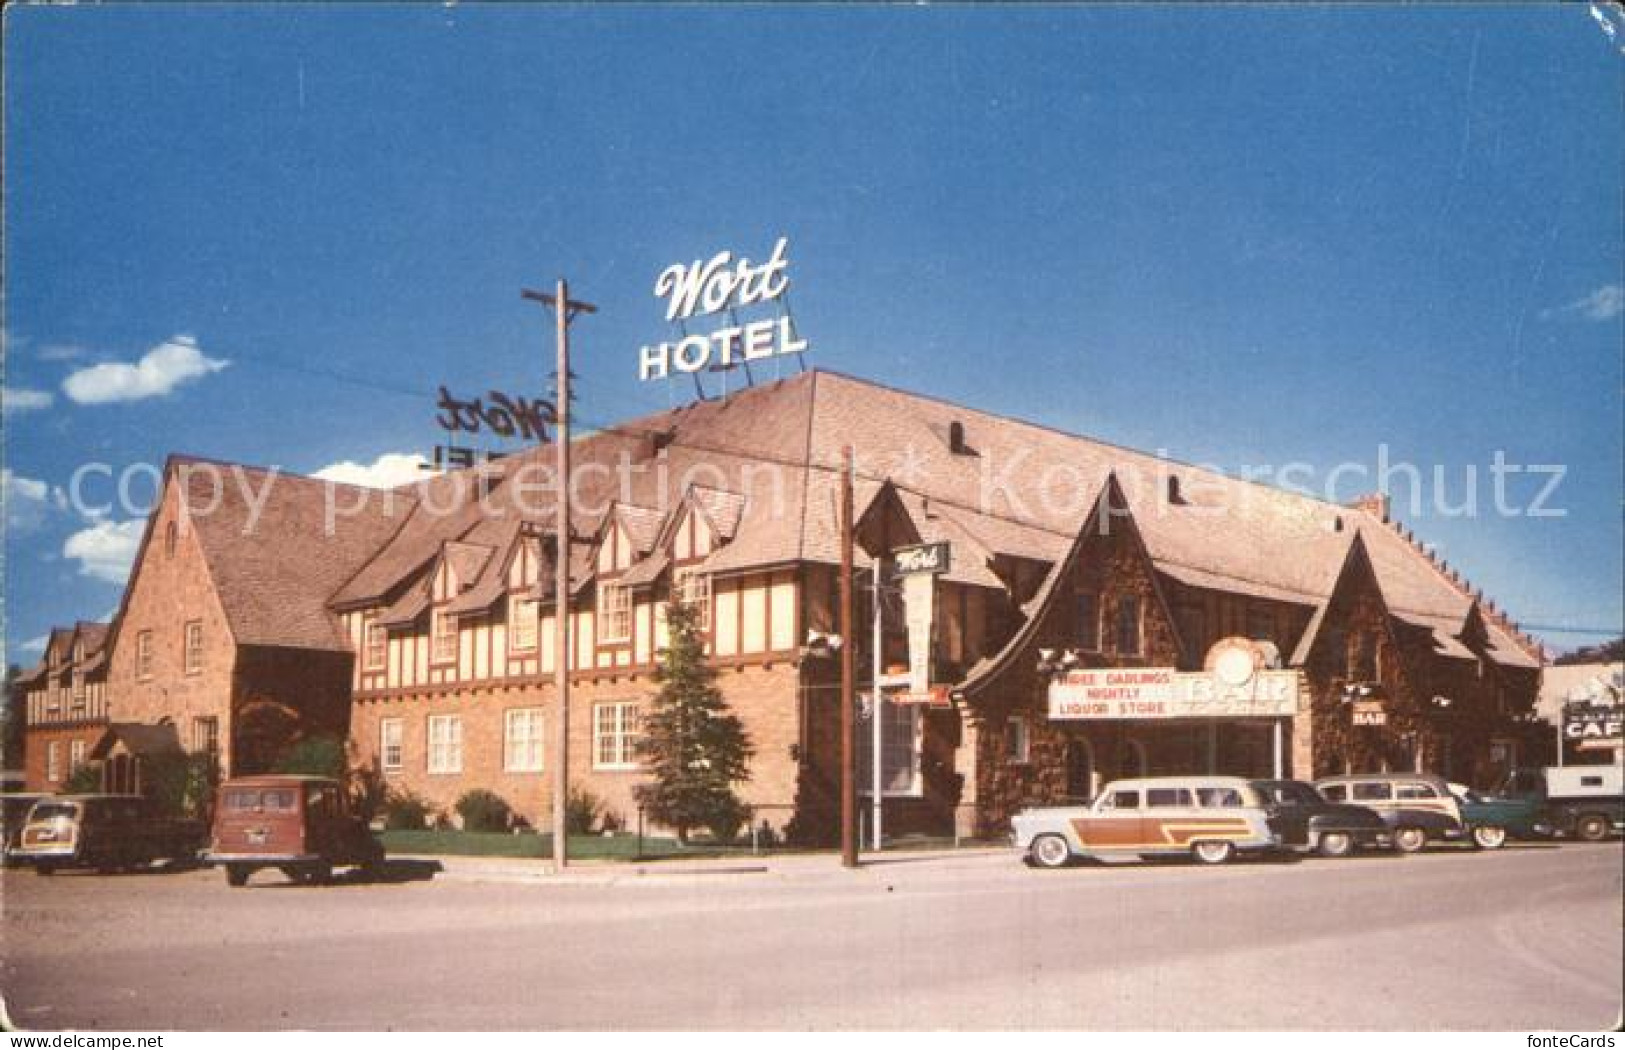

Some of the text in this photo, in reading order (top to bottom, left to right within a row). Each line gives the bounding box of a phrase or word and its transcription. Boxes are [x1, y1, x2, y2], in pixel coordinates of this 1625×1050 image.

[654, 237, 789, 322] Wort
[639, 315, 808, 381] HOTEL
[1059, 701, 1166, 714] LIQUOR STORE
[1353, 712, 1388, 726] BAR
